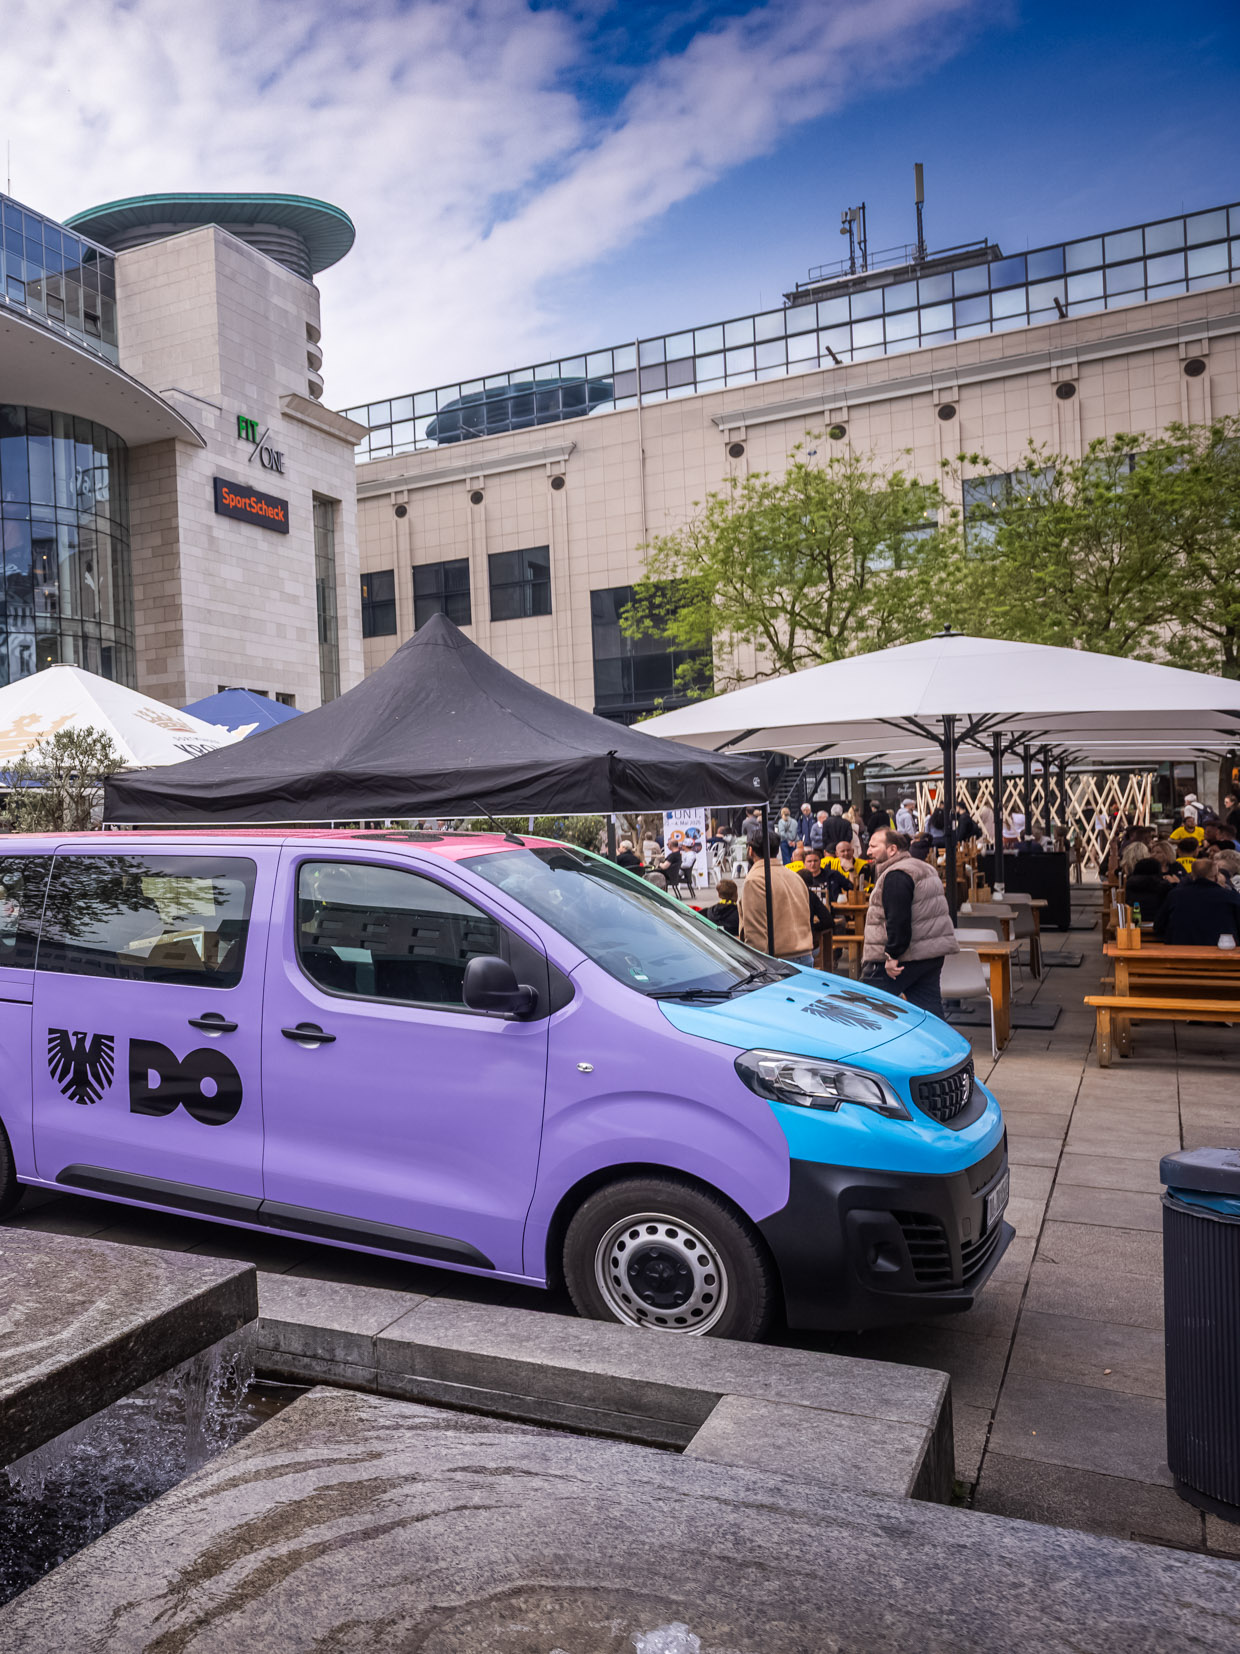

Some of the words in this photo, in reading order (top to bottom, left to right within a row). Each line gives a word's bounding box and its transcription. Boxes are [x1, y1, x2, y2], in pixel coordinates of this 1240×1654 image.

[238, 415, 259, 444] FIT
[261, 446, 285, 475] ONE
[222, 487, 285, 522] SportScheck
[129, 1038, 243, 1126] DO
